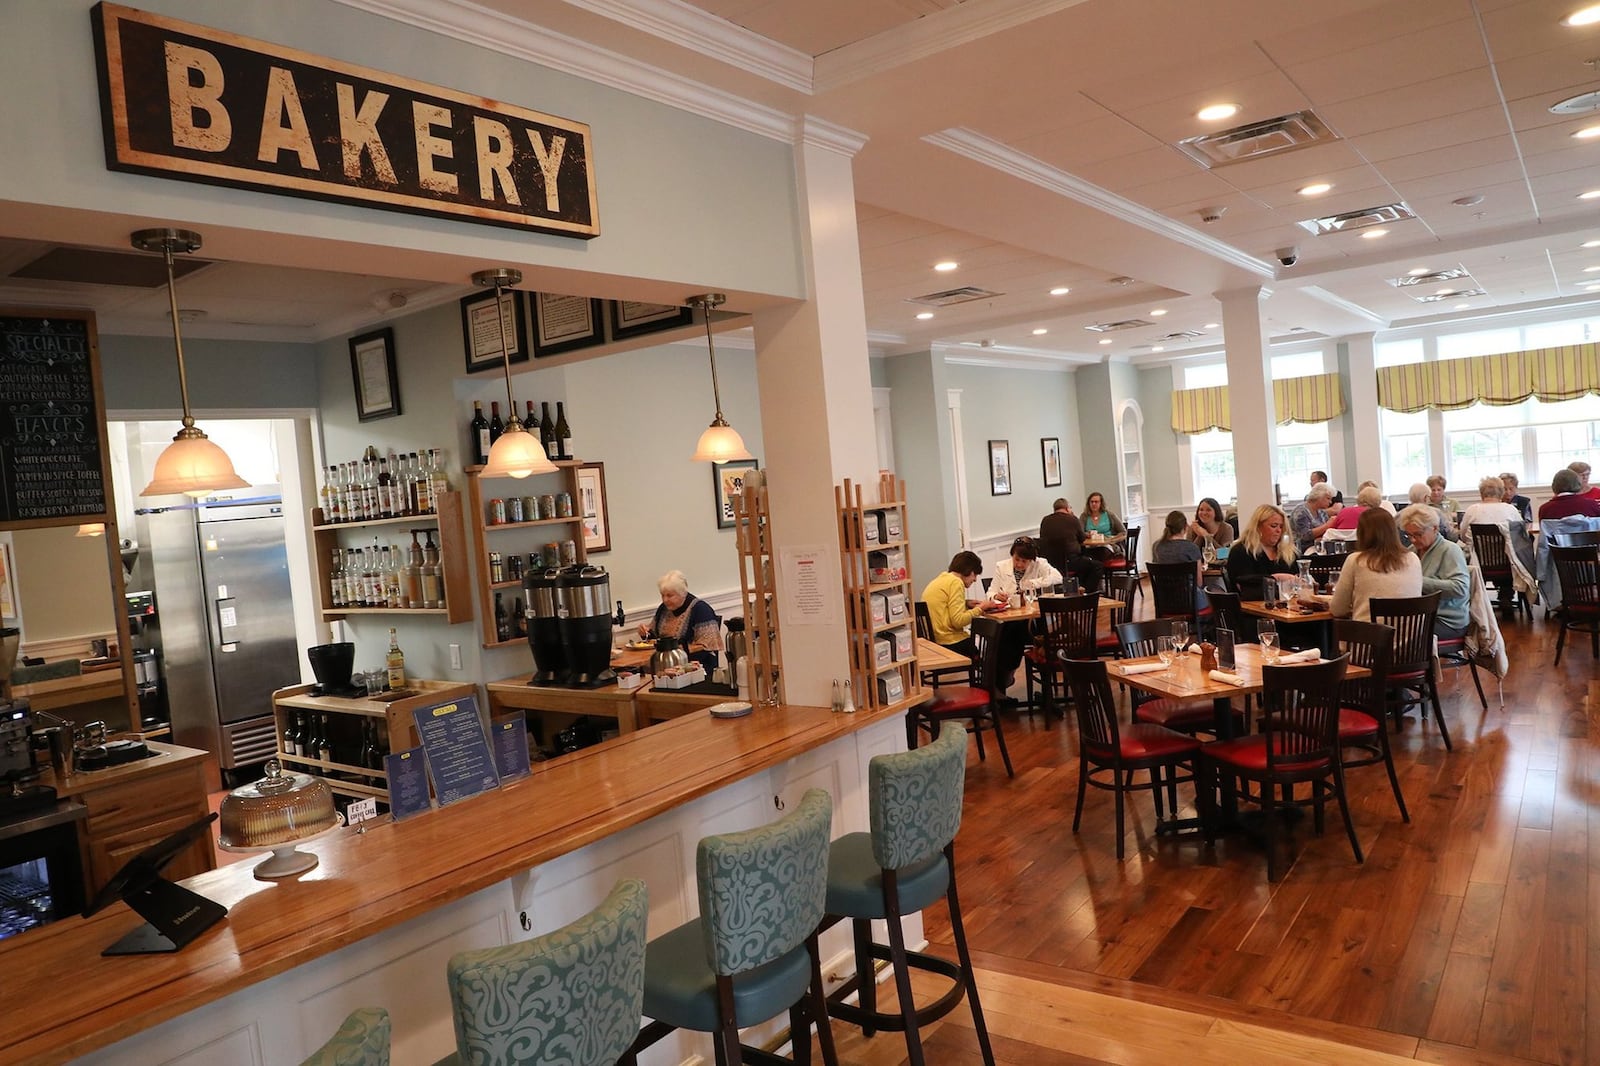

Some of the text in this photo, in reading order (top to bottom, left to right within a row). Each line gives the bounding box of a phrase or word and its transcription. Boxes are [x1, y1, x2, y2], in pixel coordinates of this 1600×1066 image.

[163, 39, 567, 214] BAKERY
[7, 335, 85, 353] SPECIALTY
[0, 374, 42, 384] SOUTHERN
[43, 374, 70, 383] BELLE
[0, 391, 29, 400] KEITH
[31, 391, 72, 400] RICHARDS
[14, 455, 40, 464] WHITE
